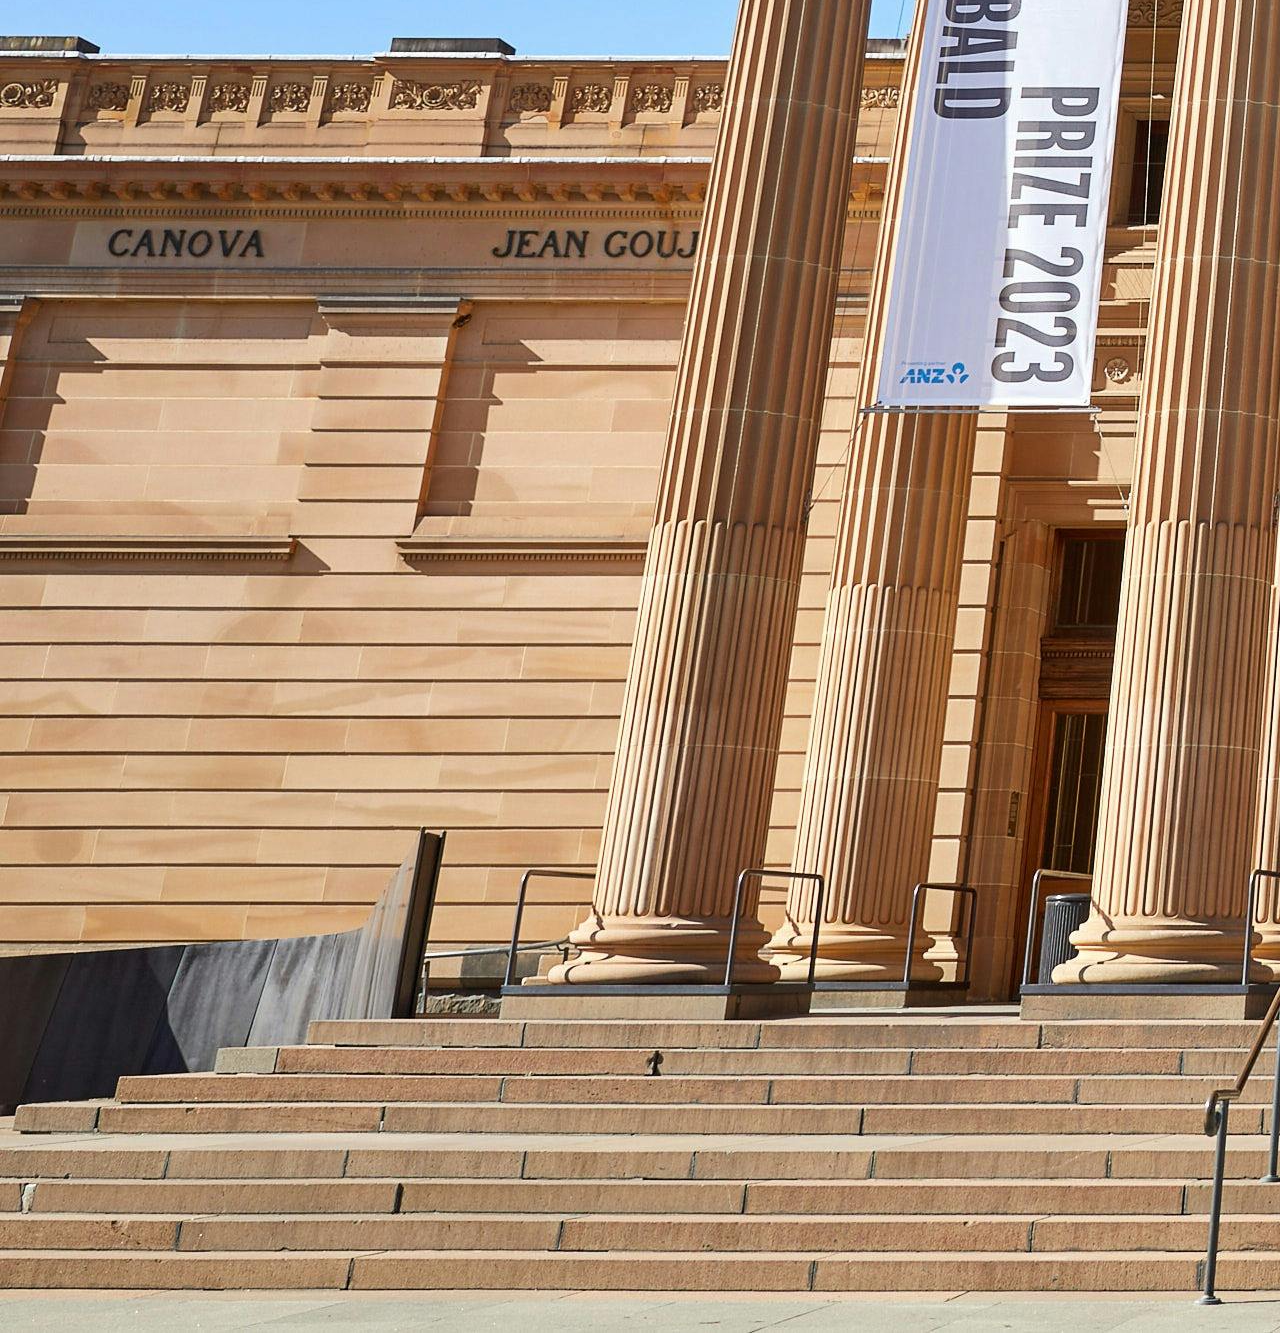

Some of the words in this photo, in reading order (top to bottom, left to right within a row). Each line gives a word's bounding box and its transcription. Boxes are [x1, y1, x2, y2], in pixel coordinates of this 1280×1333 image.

[1007, 86, 1101, 228] PRIZE
[107, 228, 265, 258] CANOVA
[491, 229, 590, 259] JEAN
[990, 246, 1085, 383] 2023
[900, 368, 946, 384] ANZ
